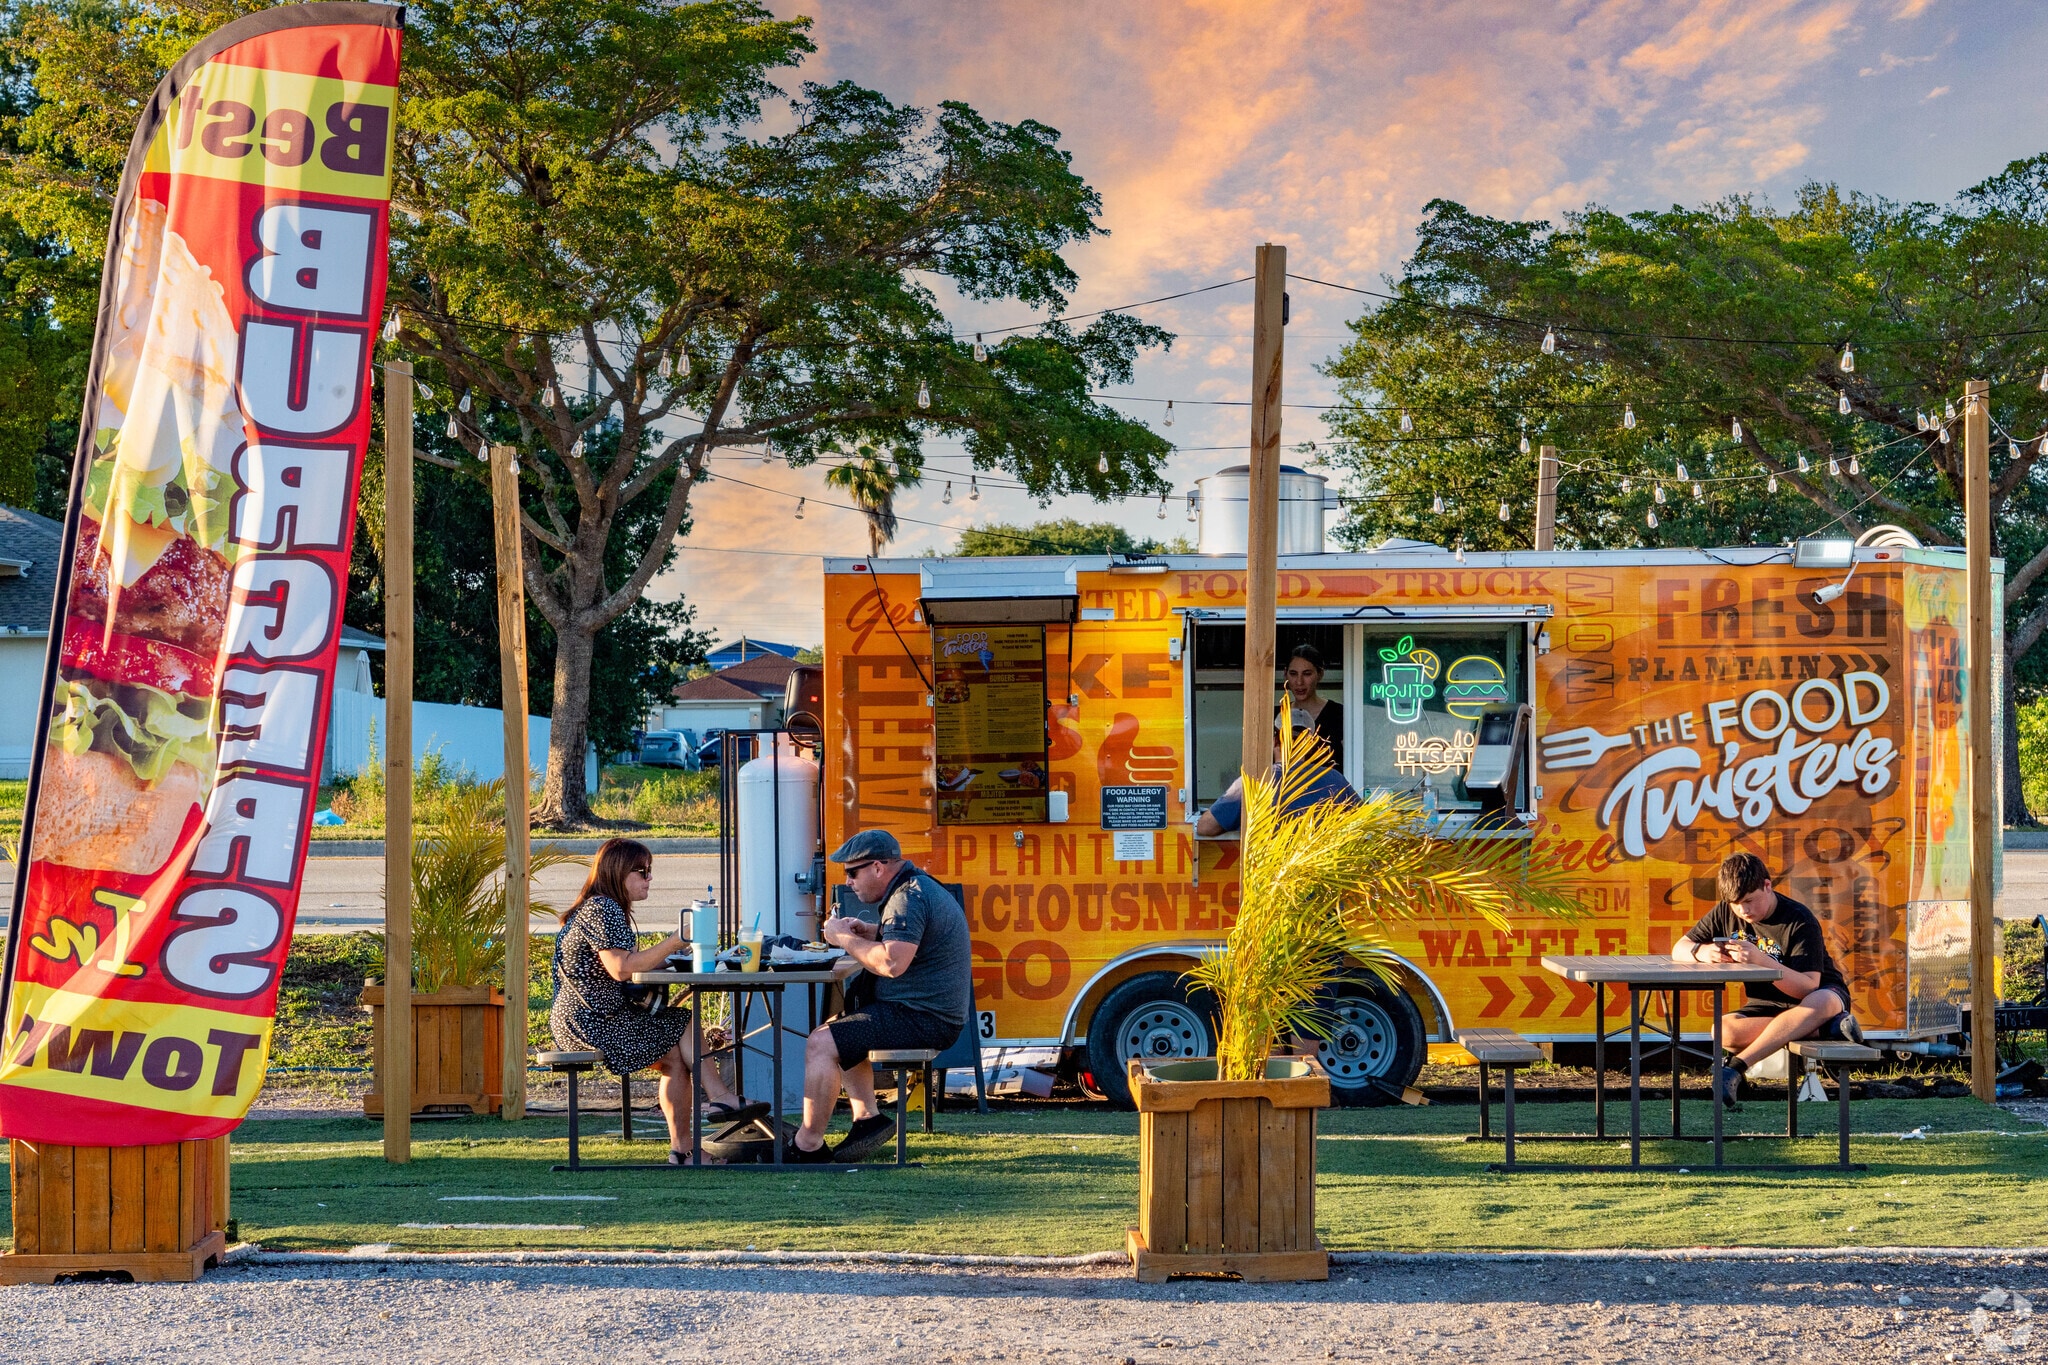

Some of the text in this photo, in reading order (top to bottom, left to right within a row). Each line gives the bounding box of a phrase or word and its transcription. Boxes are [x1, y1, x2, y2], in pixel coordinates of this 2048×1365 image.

[1177, 570, 1554, 600] FOD TRUCK
[1657, 577, 1889, 640] FRESH
[956, 631, 988, 642] FOOD
[1566, 572, 1615, 704] WOW
[1628, 655, 1821, 682] PLANTAIN
[1372, 683, 1436, 699] MOJITO
[1634, 671, 1891, 747] THE FOOD
[1396, 750, 1474, 764] LET'S EAT
[1106, 788, 1127, 796] FOOD
[1602, 727, 1898, 857] Twisters
[1679, 826, 1898, 875] ENJOY
[1418, 929, 1627, 967] WAFFLE
[1853, 875, 1880, 994] TWISTED
